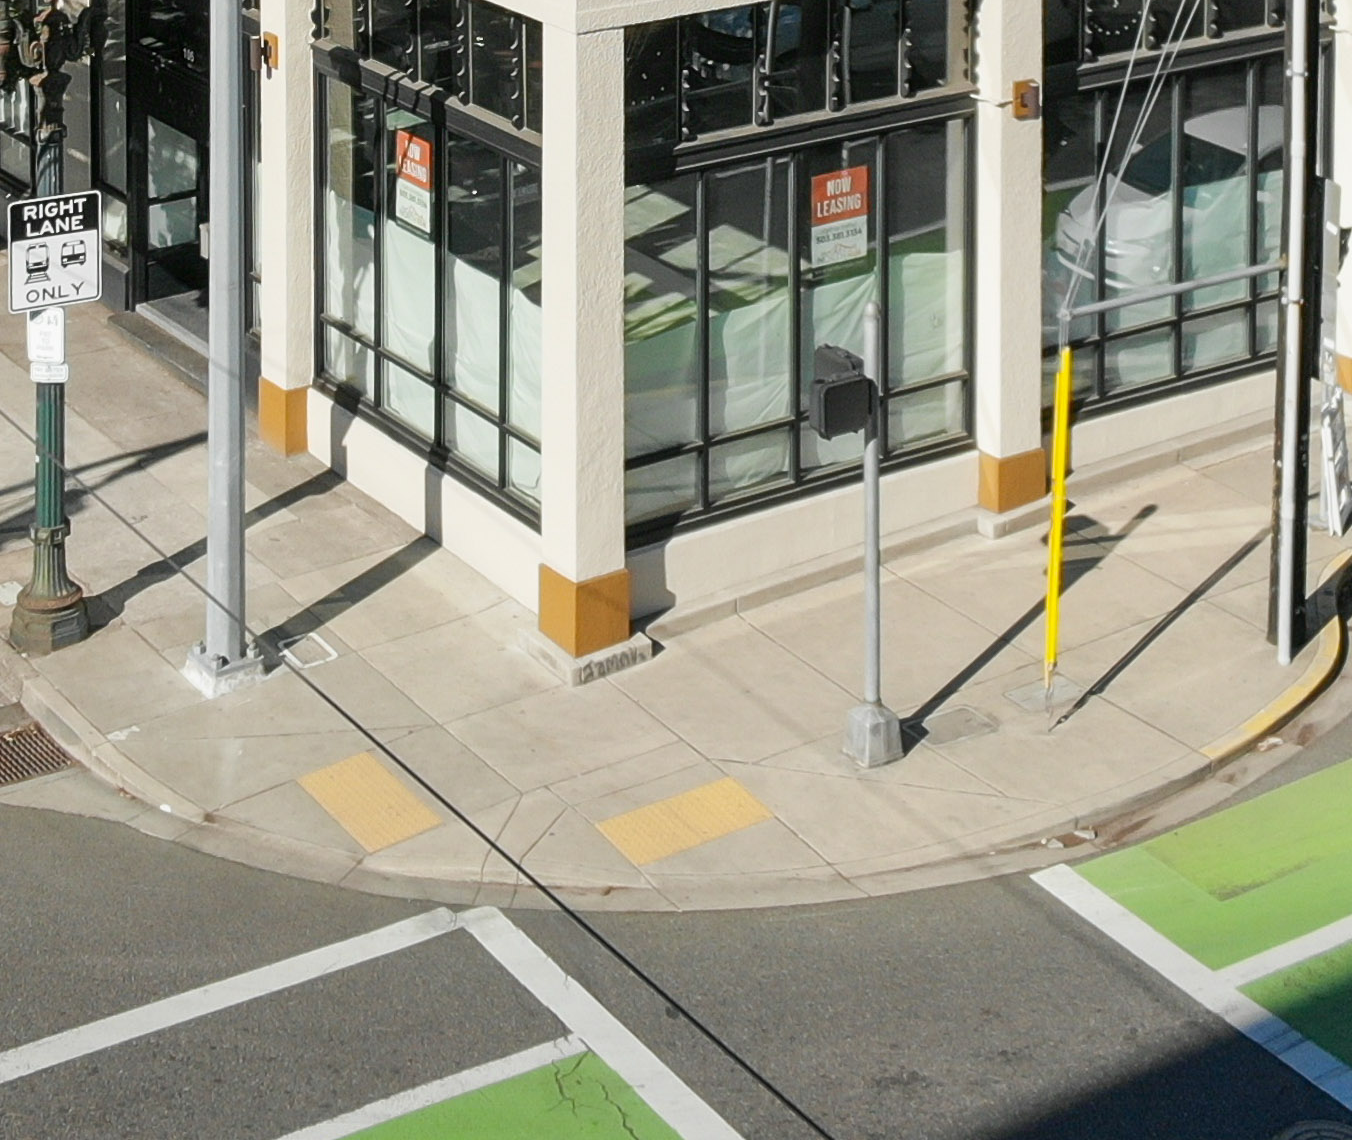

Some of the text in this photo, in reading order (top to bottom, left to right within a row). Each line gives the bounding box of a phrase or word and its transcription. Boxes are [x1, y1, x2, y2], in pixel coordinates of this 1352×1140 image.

[826, 176, 852, 197] NOW
[23, 198, 88, 222] RIGHT
[816, 193, 862, 218] LEASING
[26, 214, 84, 238] LANE
[26, 281, 85, 304] ONLY
